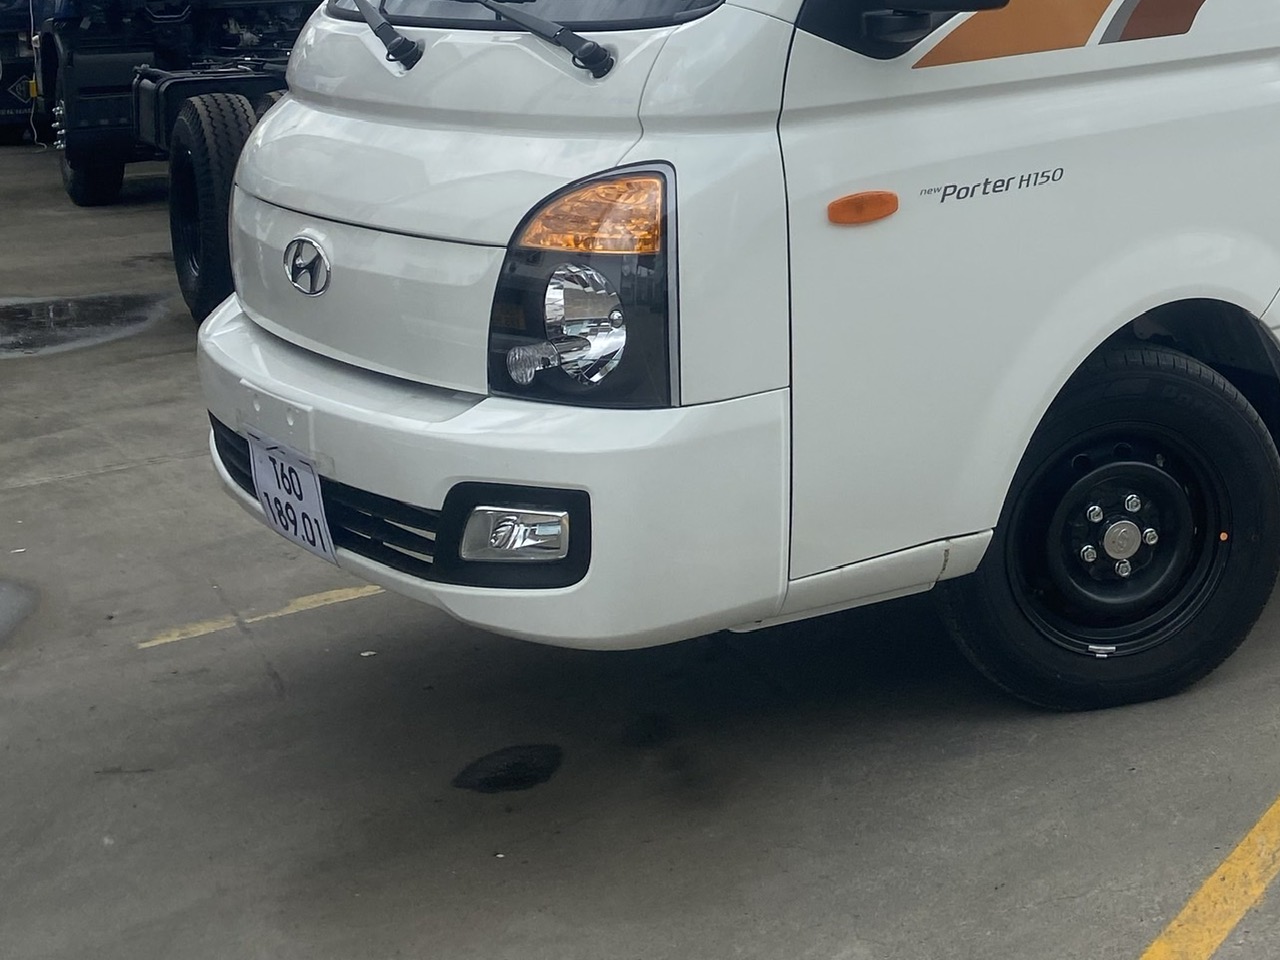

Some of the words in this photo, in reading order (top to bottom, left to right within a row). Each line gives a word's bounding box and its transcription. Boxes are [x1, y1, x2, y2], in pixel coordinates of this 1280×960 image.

[920, 186, 942, 196] new
[940, 176, 1016, 204] Porter
[1017, 167, 1064, 190] H150
[268, 455, 304, 502] T60
[263, 491, 327, 553] 189.01
